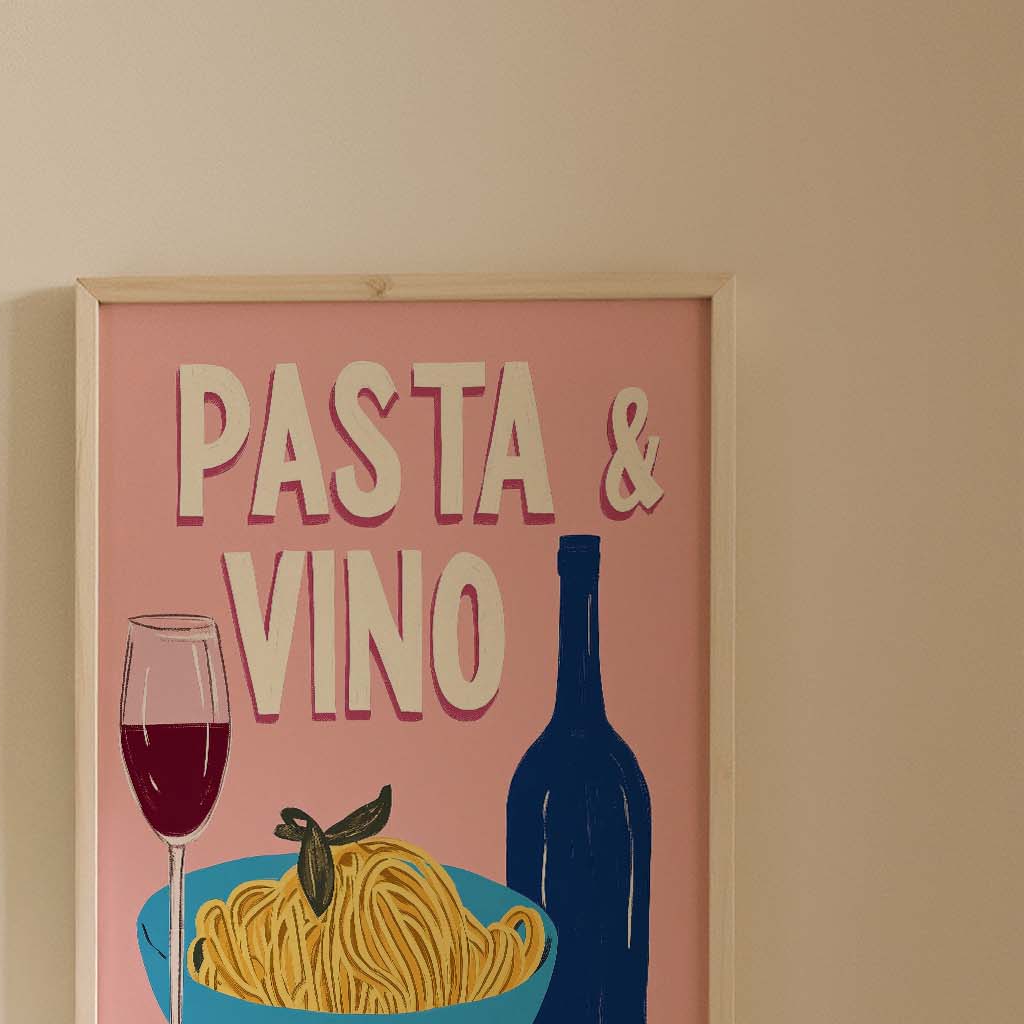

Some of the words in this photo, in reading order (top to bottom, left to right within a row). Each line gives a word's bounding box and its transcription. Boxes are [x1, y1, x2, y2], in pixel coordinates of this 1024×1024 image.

[176, 361, 555, 527] PASTA
[599, 387, 664, 521] &
[221, 549, 505, 723] VINO
